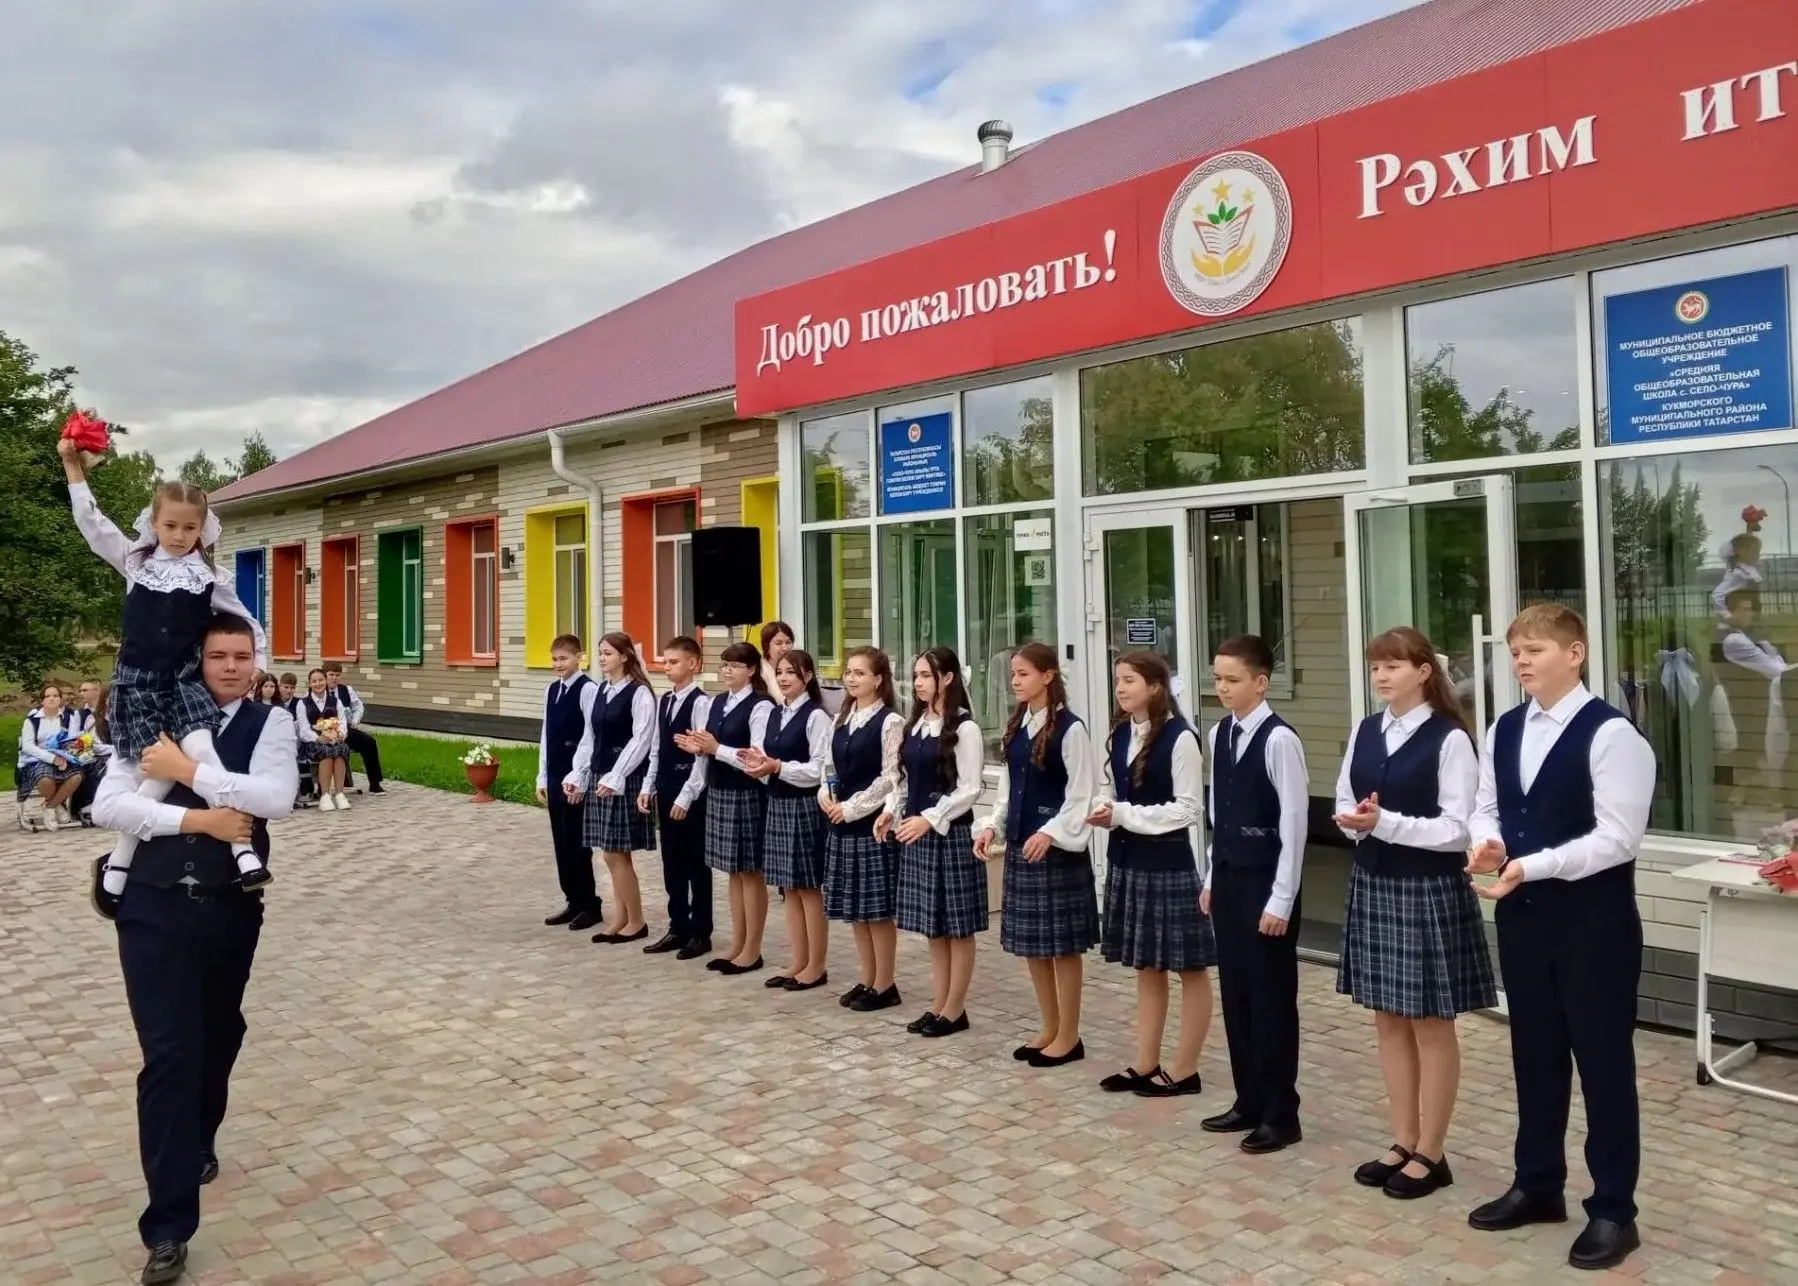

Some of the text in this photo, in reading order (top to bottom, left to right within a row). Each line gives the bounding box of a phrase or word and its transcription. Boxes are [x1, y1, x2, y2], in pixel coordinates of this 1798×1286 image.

[1356, 115, 1598, 219] Рәхим
[757, 229, 1118, 377] Добро пожаловать!
[1620, 321, 1773, 350] МУНИЦИПАЛЬНОЕ БЮДЖЕТНОЕ
[1632, 334, 1759, 358] ОБЩЕОБРАЗОВАТЕЛЬНОЕ
[1662, 348, 1727, 364] УЧРЕЖДЕНИЕ
[1634, 369, 1760, 392] ОБЩЕОБРАЗОВАТЕЛЬНАЯ
[1670, 364, 1721, 377] «СРЕДНЯЯ
[1643, 388, 1677, 400] ШКОЛА
[1689, 382, 1750, 395] СЕЛО-ЧУРА»
[1631, 402, 1767, 424] МУНИЦИПАЛЬНОГО РАЙОНА
[1662, 397, 1733, 411] КУКМОРСКОГО
[1639, 414, 1760, 433] РЕСПУБЛИКИ ТАТАРСТАН
